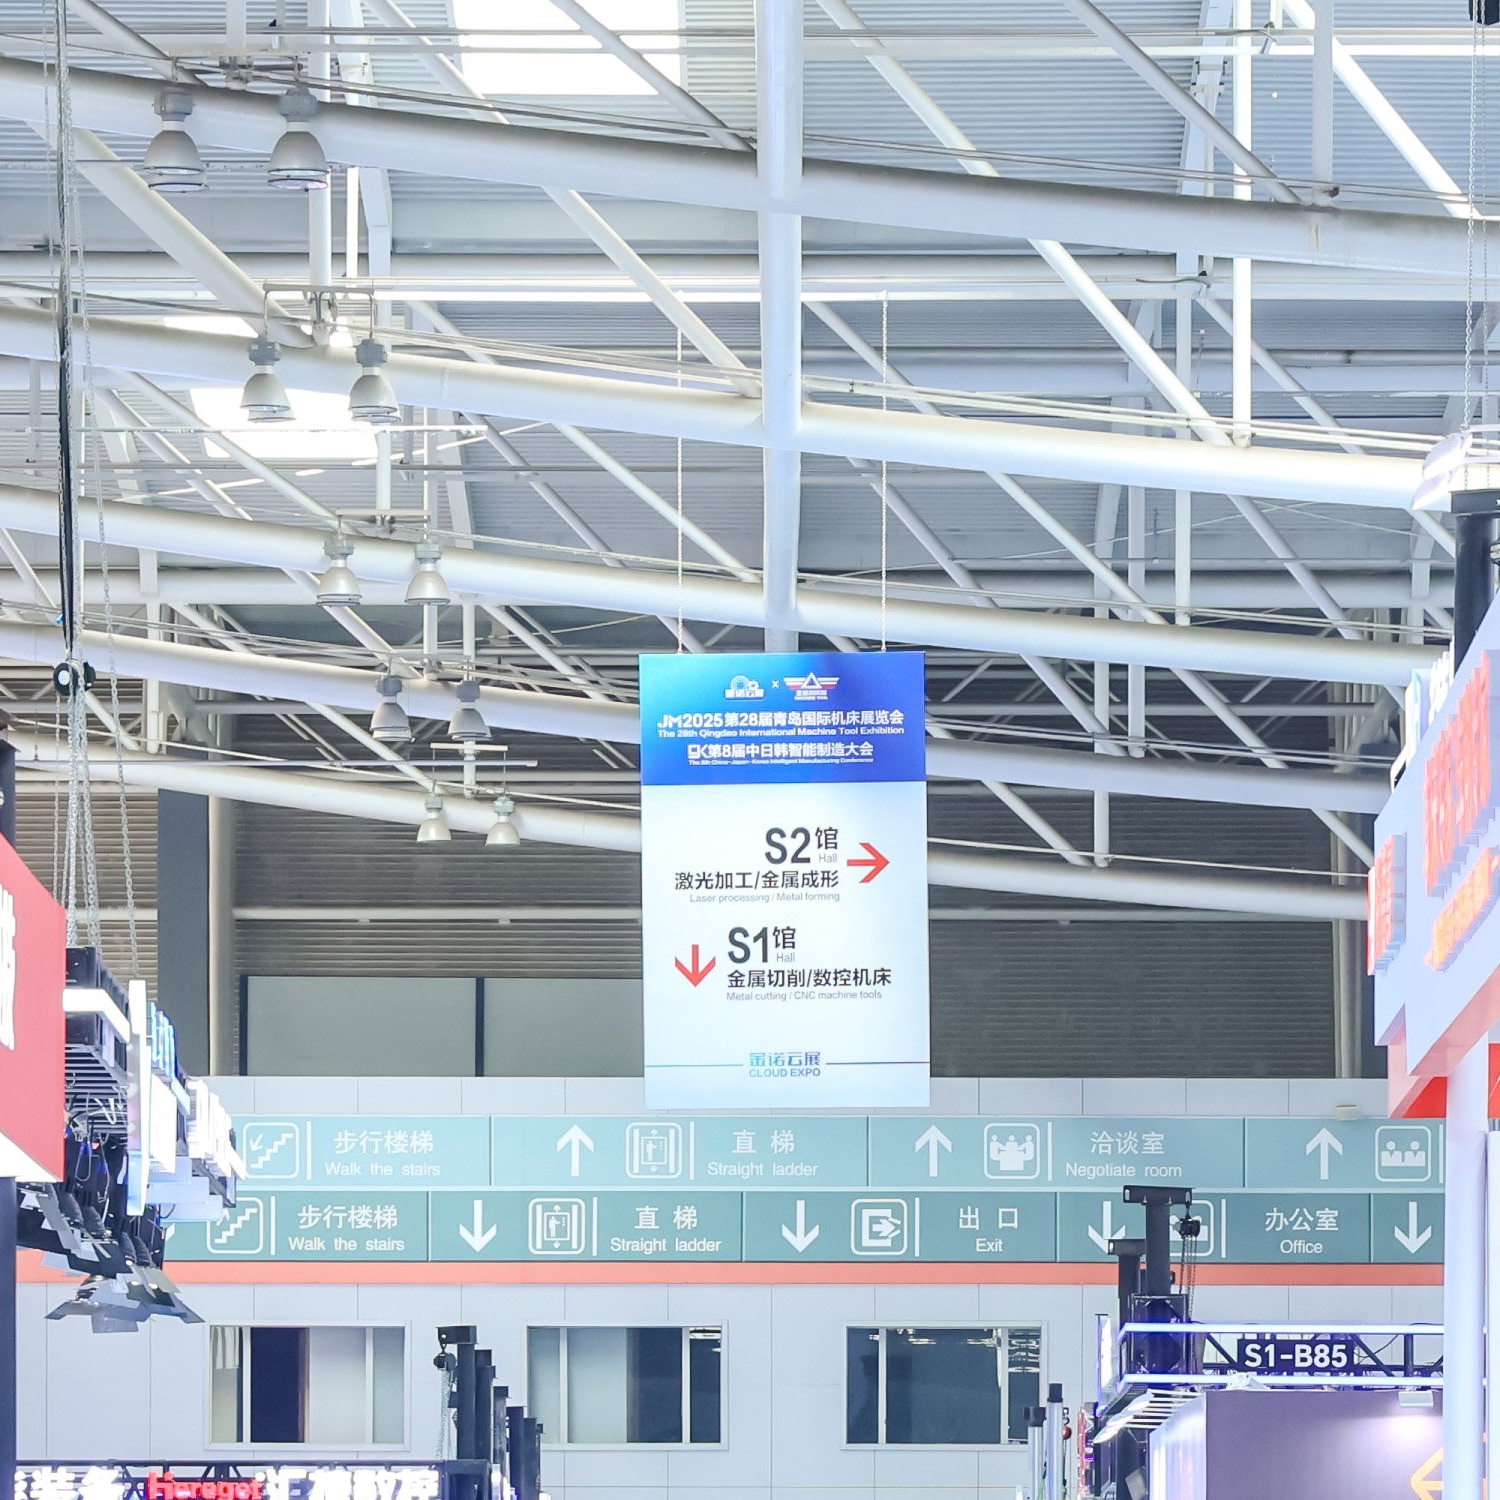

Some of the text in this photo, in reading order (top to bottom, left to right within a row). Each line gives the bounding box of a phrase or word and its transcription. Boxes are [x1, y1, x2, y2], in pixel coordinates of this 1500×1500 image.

[658, 726, 905, 739] The 28th Qingdao International Machine Tool Exhibition
[818, 853, 838, 863] Hall
[674, 870, 839, 890] 激光加工/金属成形
[689, 894, 717, 903] Laser
[719, 893, 770, 905] processing
[776, 892, 803, 901] Metal
[805, 892, 840, 903] forming
[776, 952, 796, 963] Hall
[727, 967, 892, 988] 金属切削/数控机床
[726, 991, 753, 1001] Metal
[754, 990, 787, 1002] cutting
[794, 990, 816, 1000] CNC
[818, 989, 858, 1000] machine
[859, 989, 883, 999] tools
[749, 1067, 821, 1078] CLOUD EXPO
[333, 1128, 435, 1155] 步行楼梯
[1090, 1129, 1166, 1157] 洽谈室
[324, 1161, 441, 1177] Walk the stairs
[707, 1161, 819, 1179] Straight ladder
[1065, 1162, 1183, 1180] Negotiate room
[297, 1204, 399, 1230] 步行楼梯
[1264, 1206, 1340, 1233] 办公室
[288, 1236, 405, 1252] Walk the stairs
[610, 1236, 722, 1254] Straight ladder
[975, 1238, 1003, 1253] Exit
[1279, 1239, 1323, 1254] Office
[1244, 1344, 1348, 1369] S1-B85
